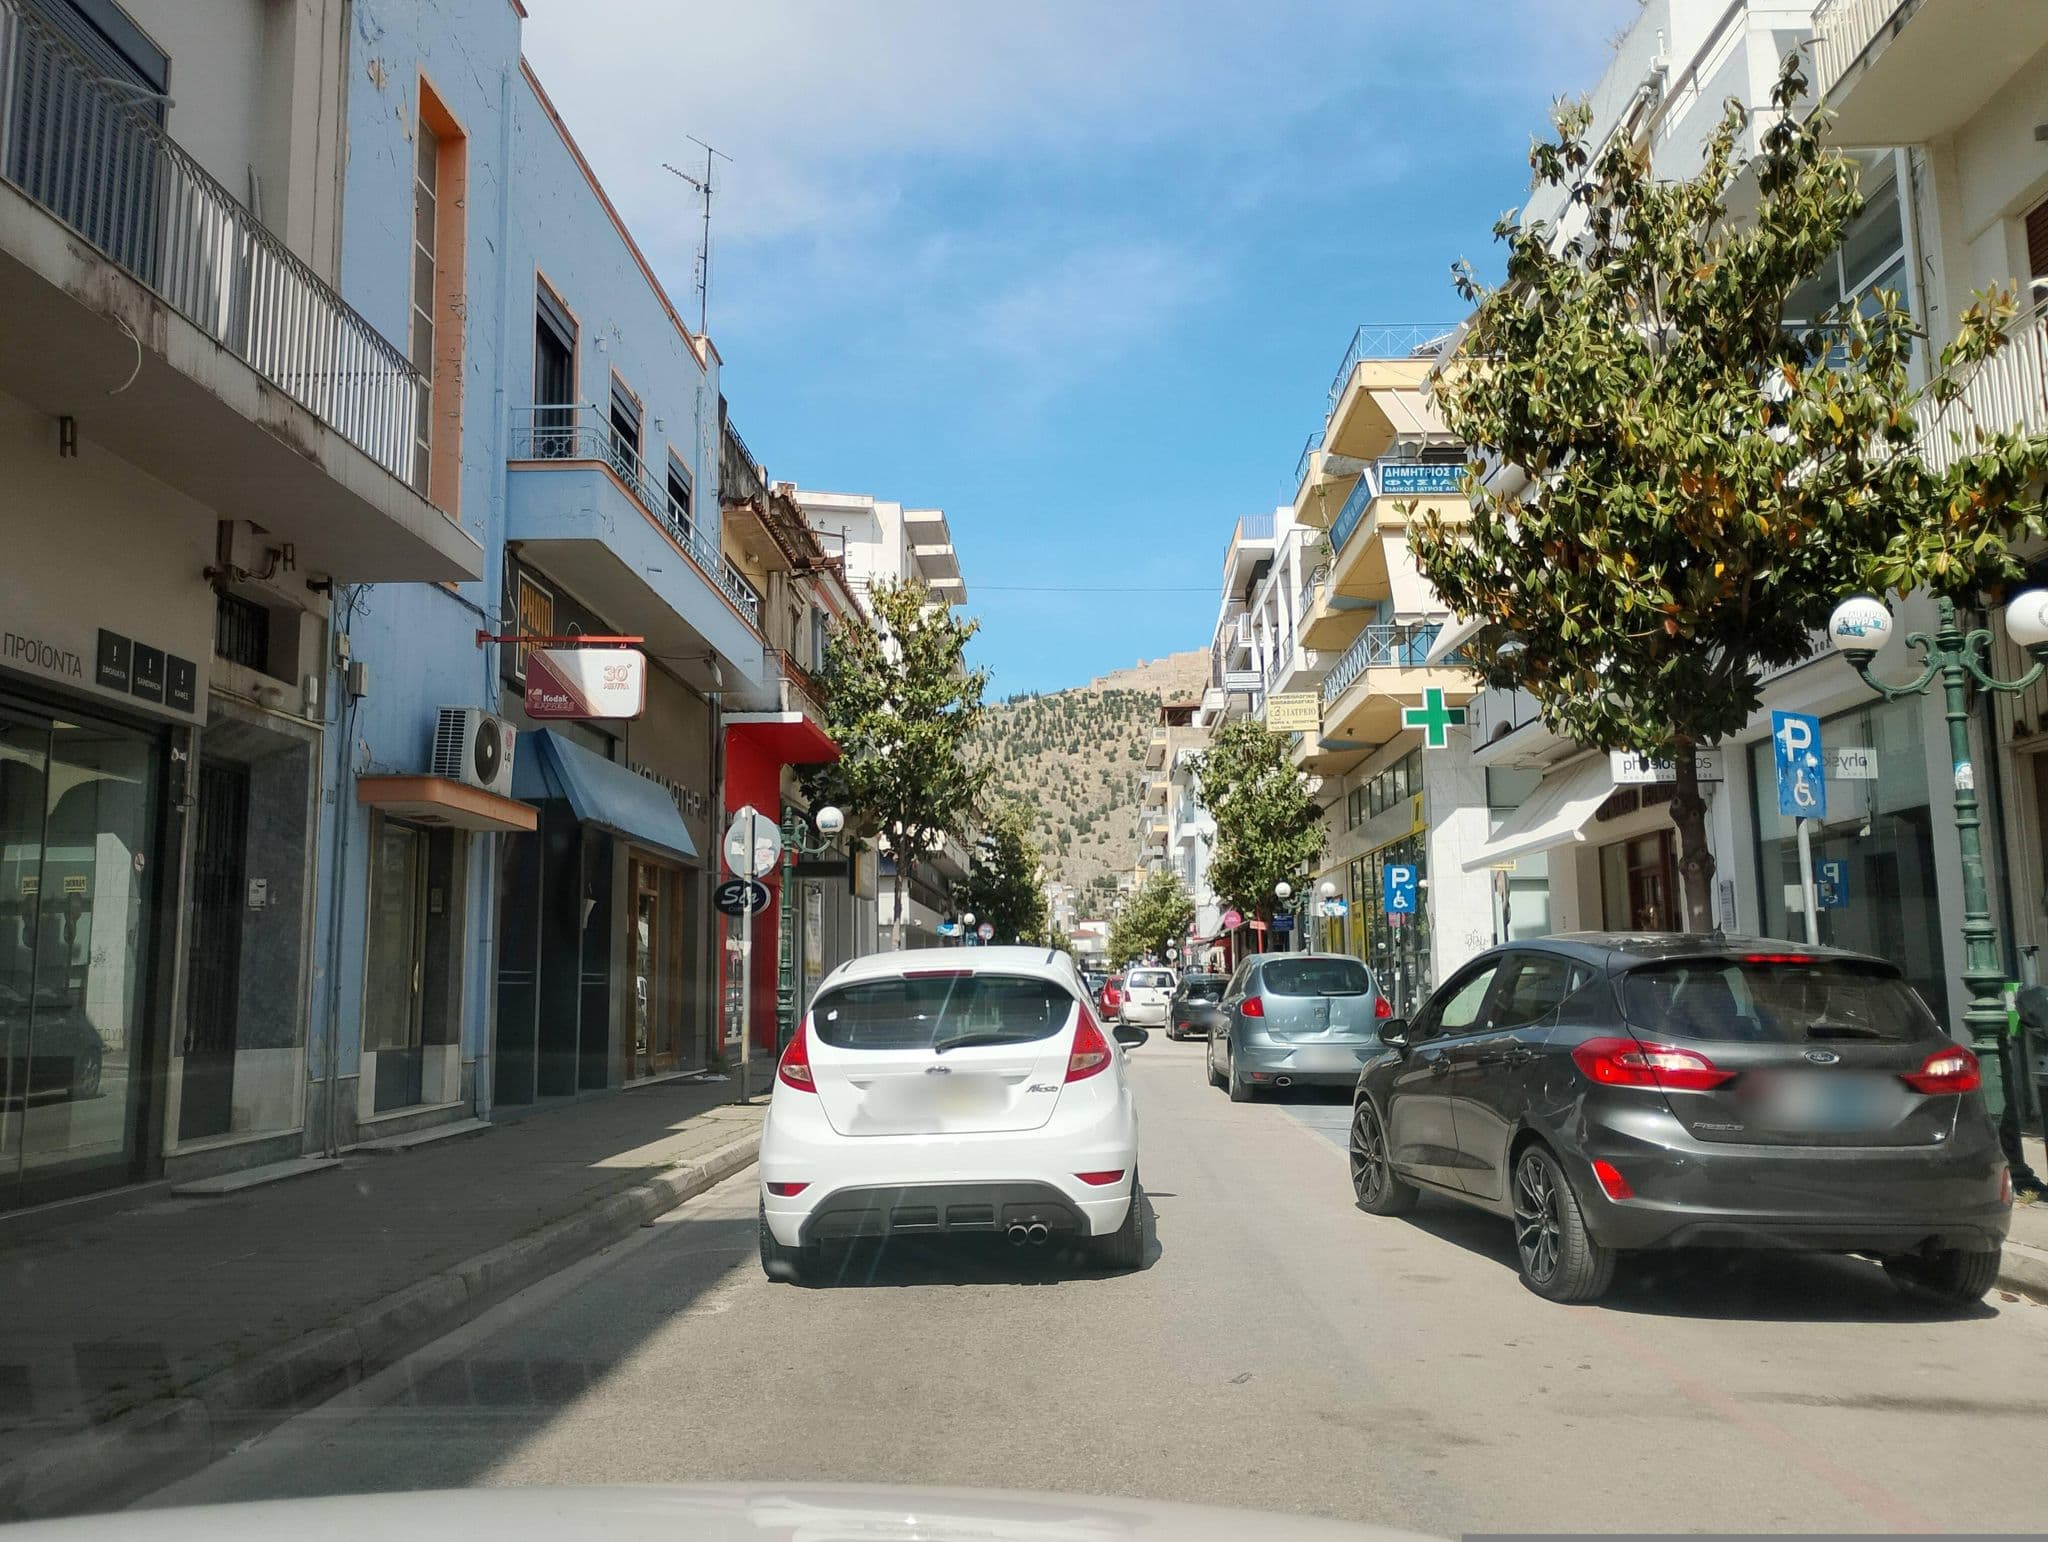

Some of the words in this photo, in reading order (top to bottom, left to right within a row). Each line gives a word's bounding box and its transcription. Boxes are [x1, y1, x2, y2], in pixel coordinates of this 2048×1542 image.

[1384, 467, 1450, 477] ΔΗΜΗΤΡΙΟΣ
[3, 632, 82, 679] ΠΡΟΪΟΝΤΑ
[543, 694, 569, 703] Kodak
[1286, 707, 1317, 717] ΙΑΤΡΕΙΟ
[1392, 868, 1410, 888] P
